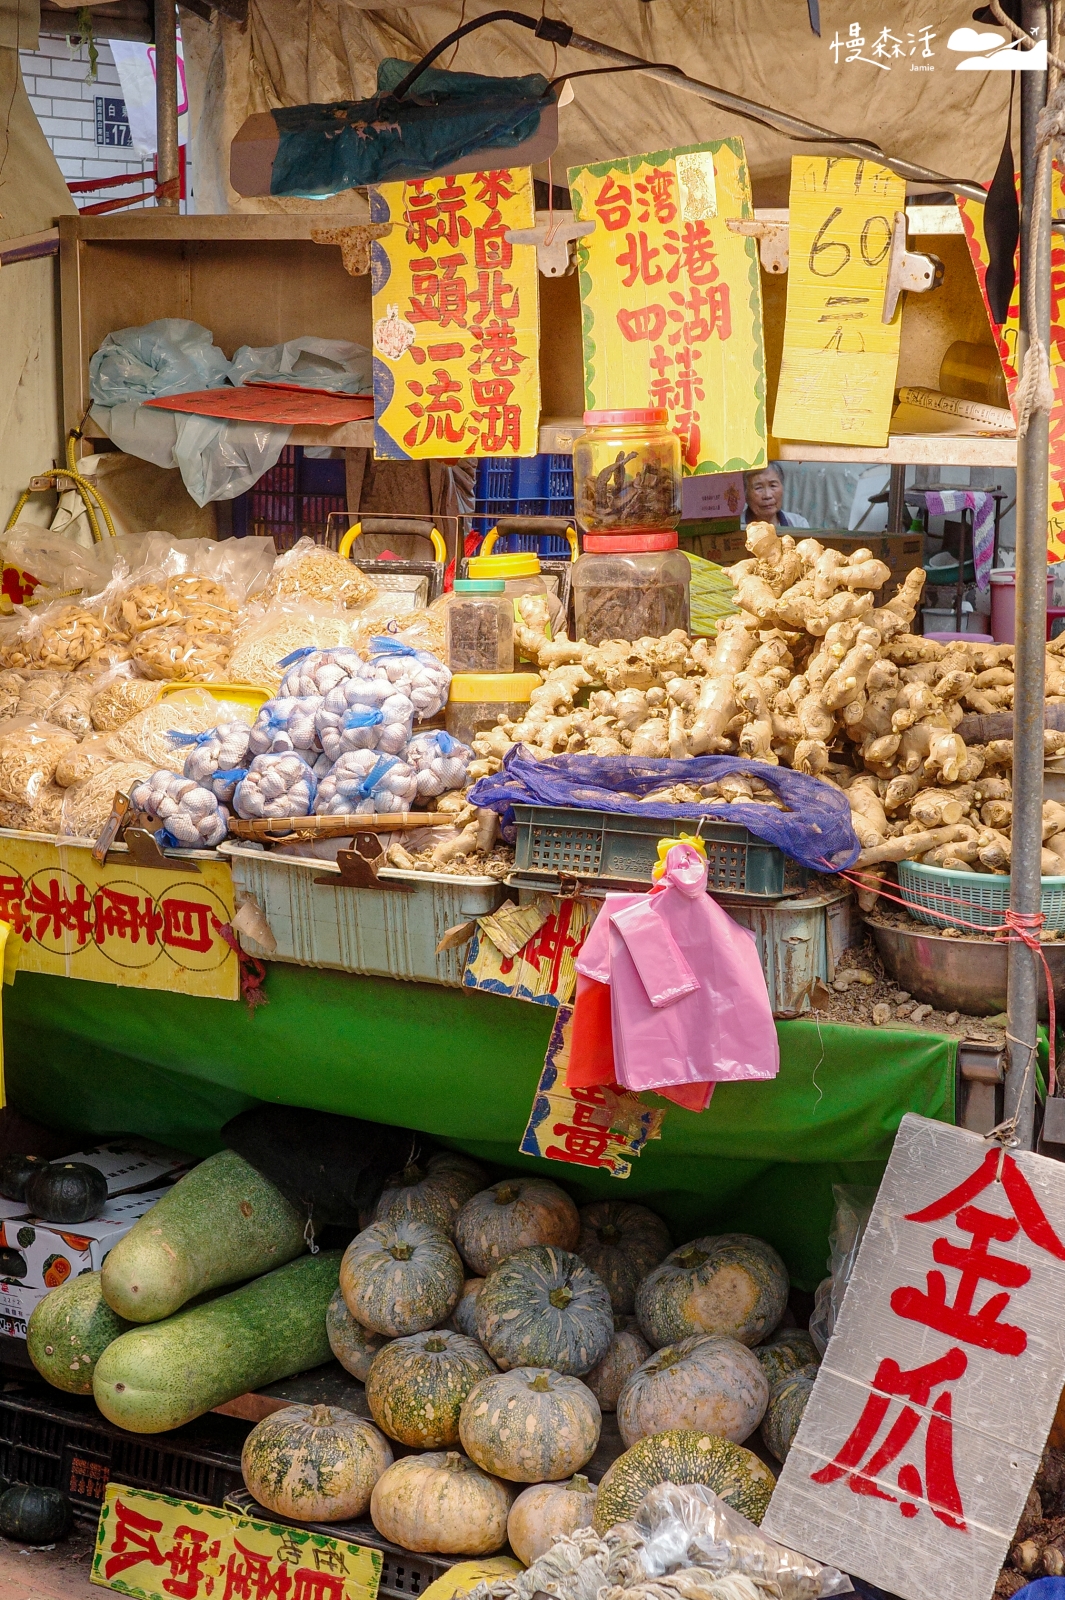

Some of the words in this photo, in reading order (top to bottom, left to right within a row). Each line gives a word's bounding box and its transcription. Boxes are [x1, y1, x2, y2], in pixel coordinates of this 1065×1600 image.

[615, 220, 720, 288] 北港
[808, 206, 892, 277] 60
[616, 282, 733, 347] 四湖
[810, 1147, 1065, 1533] 金瓜
